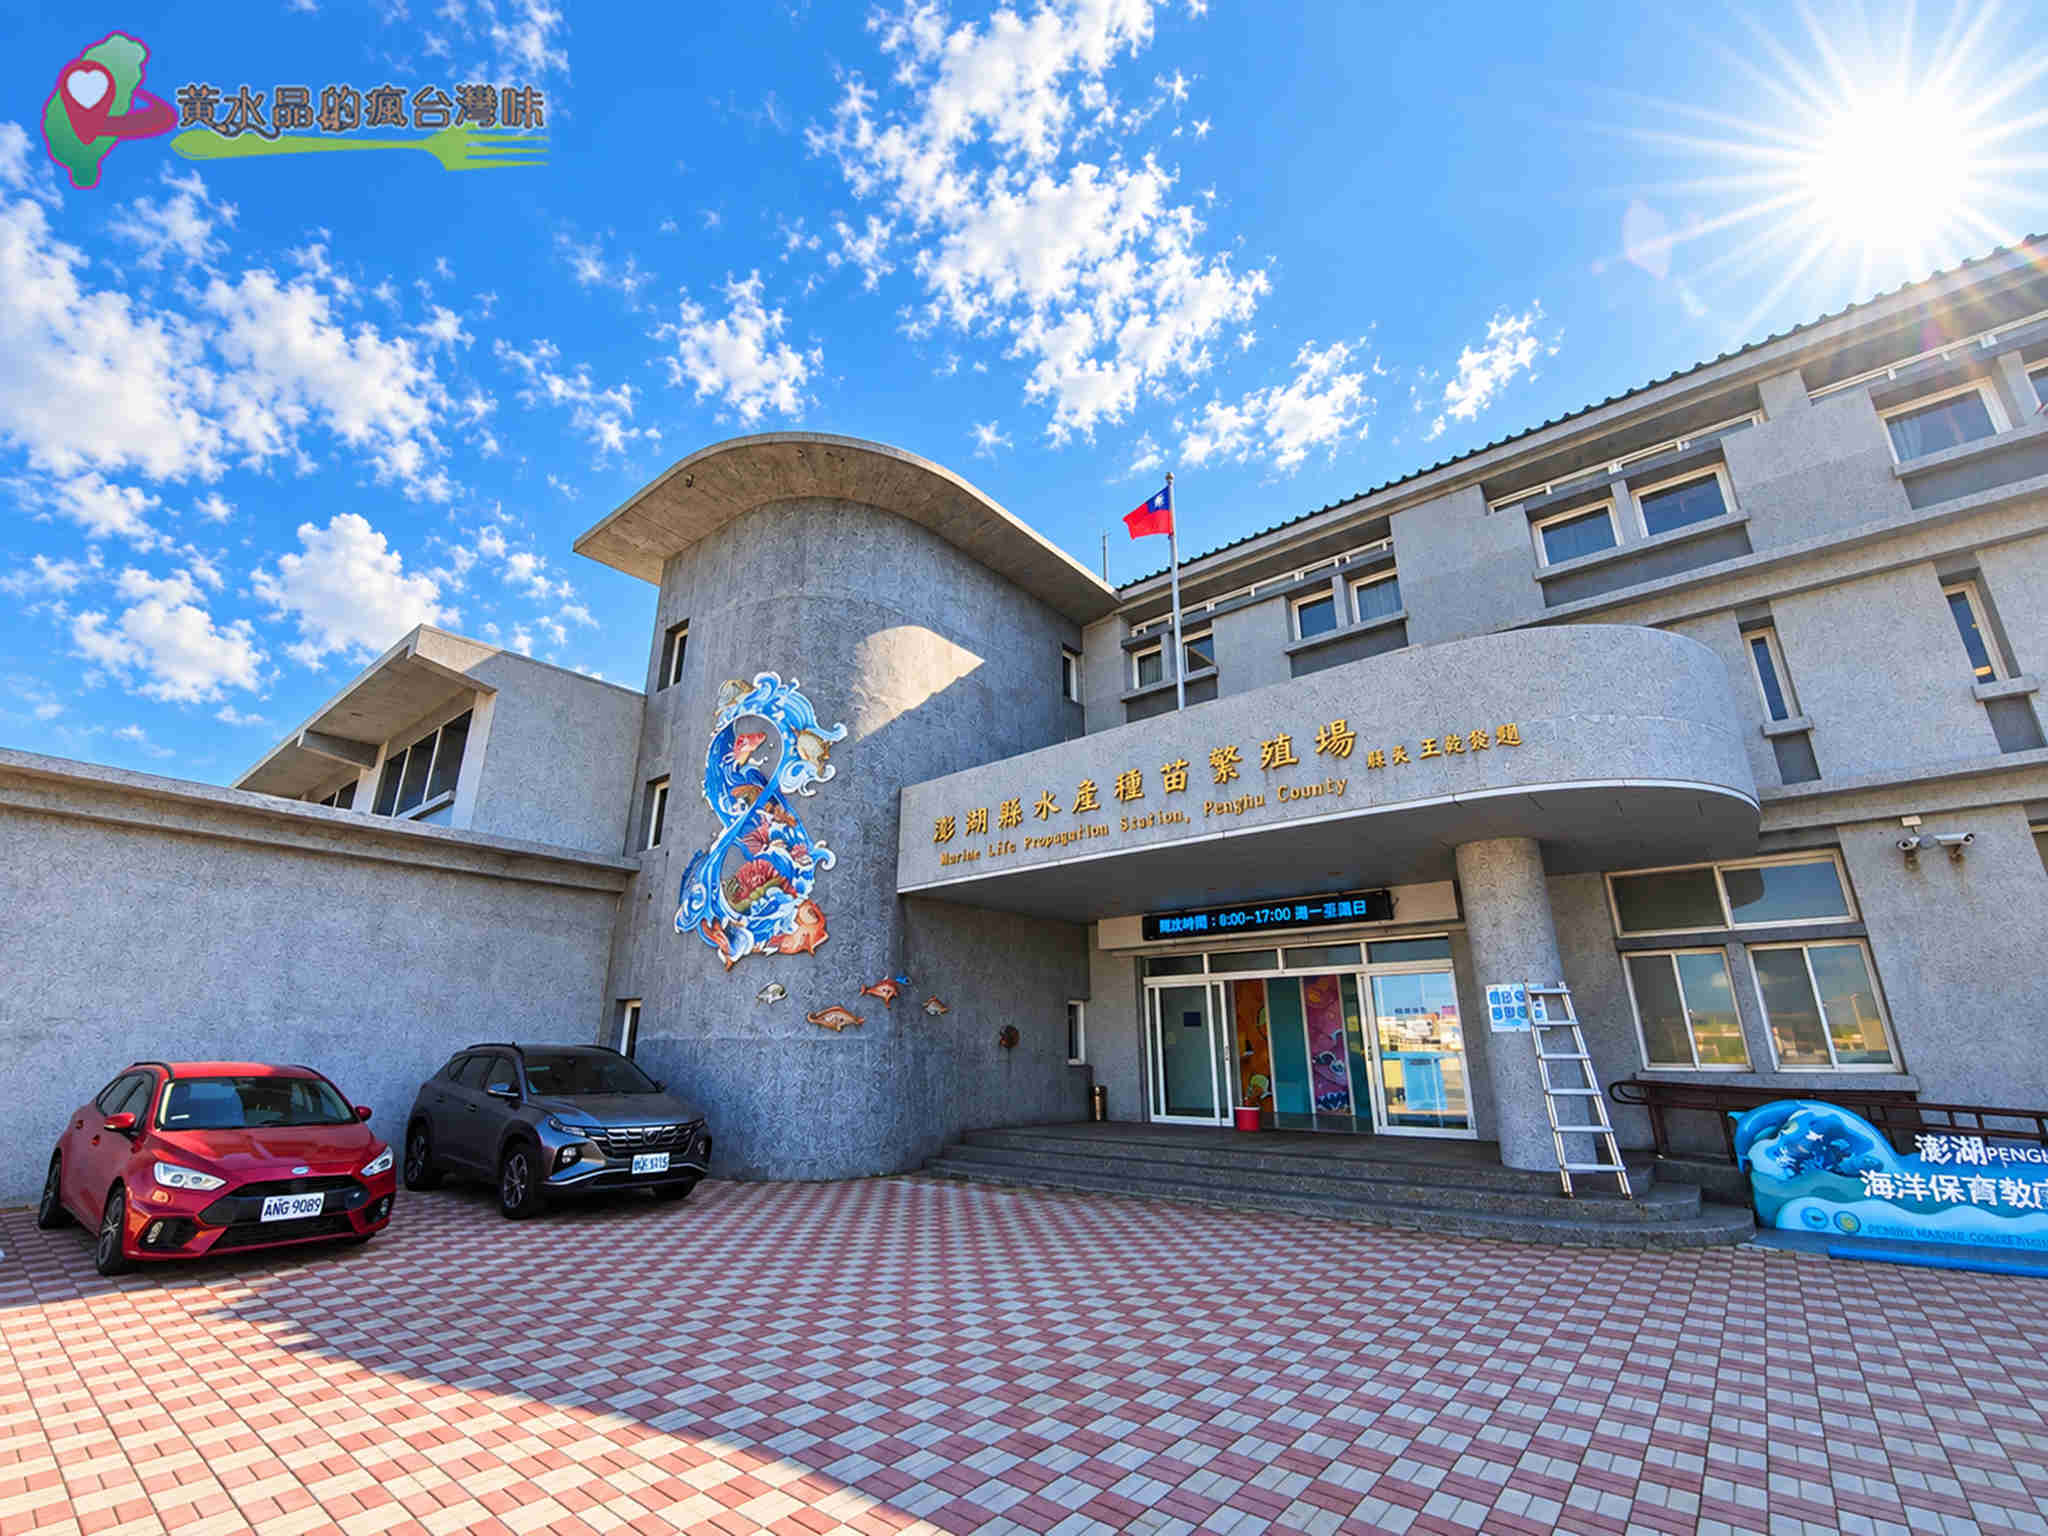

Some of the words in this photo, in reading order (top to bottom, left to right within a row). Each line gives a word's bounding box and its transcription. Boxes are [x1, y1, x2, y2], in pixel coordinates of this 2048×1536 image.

[939, 848, 981, 866] Marine
[988, 840, 1017, 858] Life
[1024, 824, 1109, 850] Propagation
[1203, 793, 1265, 817] Penghu
[1276, 777, 1348, 803] County
[1914, 1134, 1988, 1165] 澎湖
